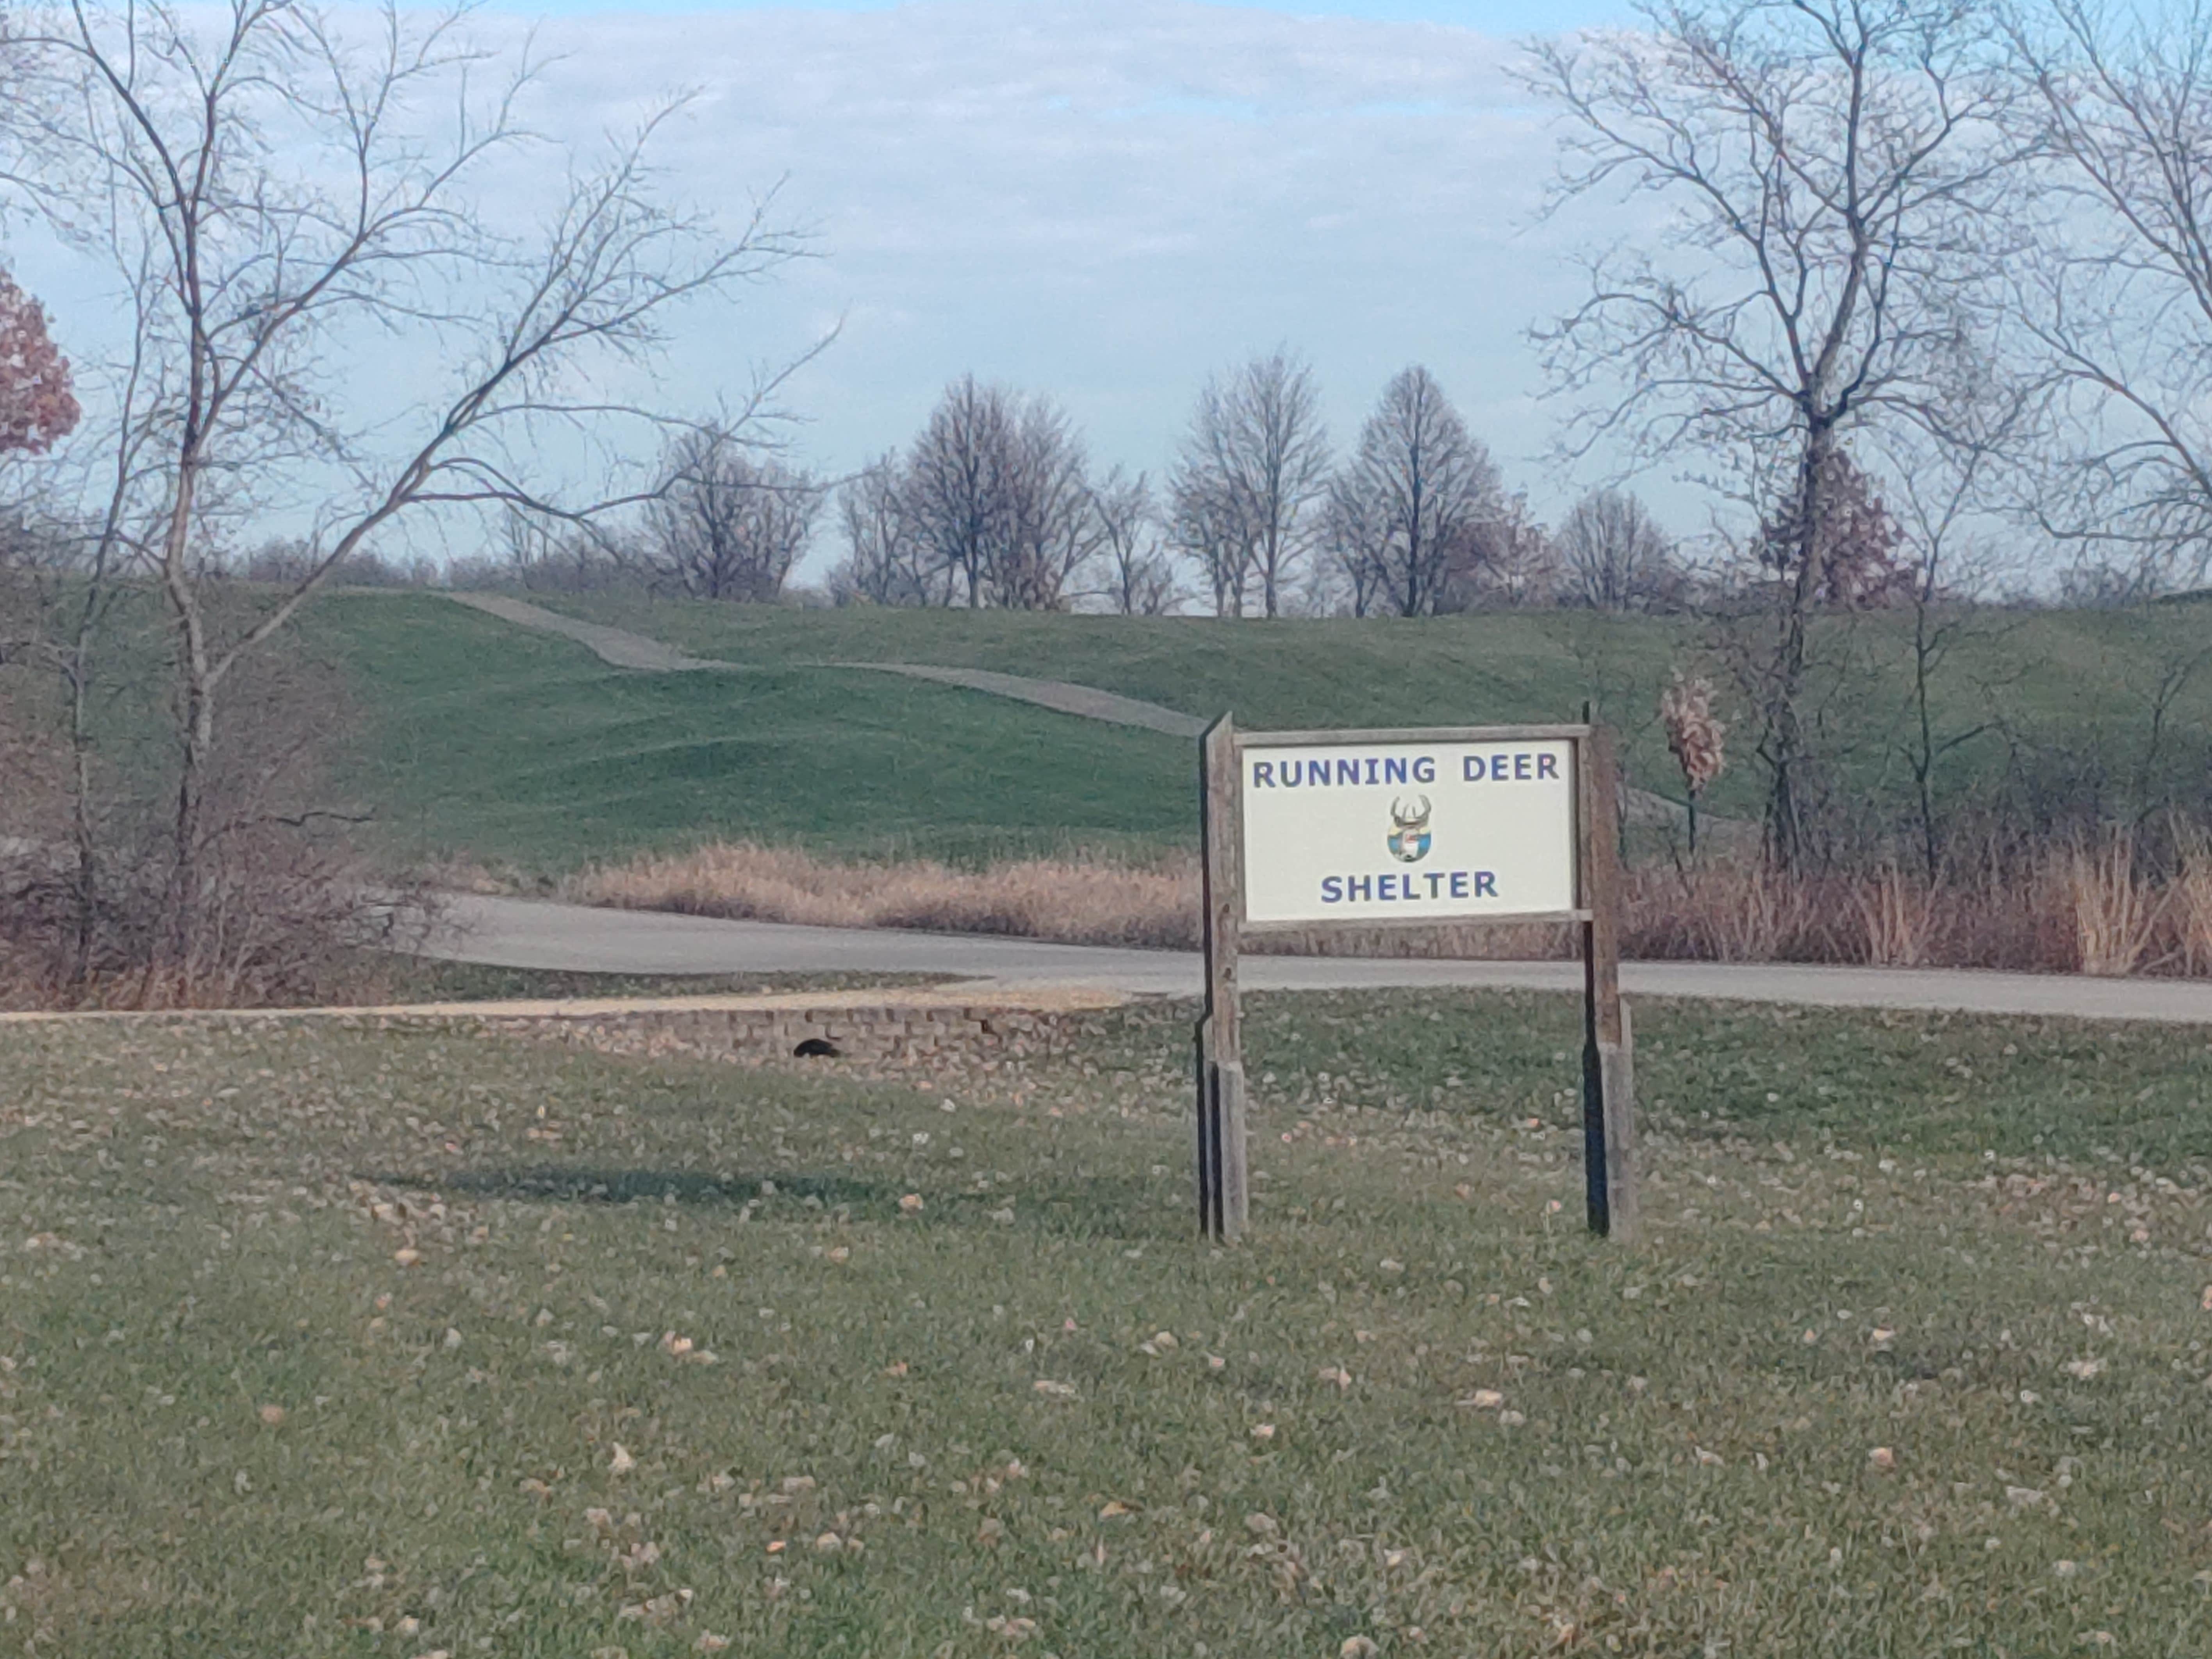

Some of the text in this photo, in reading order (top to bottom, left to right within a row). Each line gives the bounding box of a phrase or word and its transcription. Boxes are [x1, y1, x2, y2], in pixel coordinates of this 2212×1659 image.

[1253, 753, 1560, 788] RUNNING DEER
[1321, 871, 1498, 903] SHELTER
